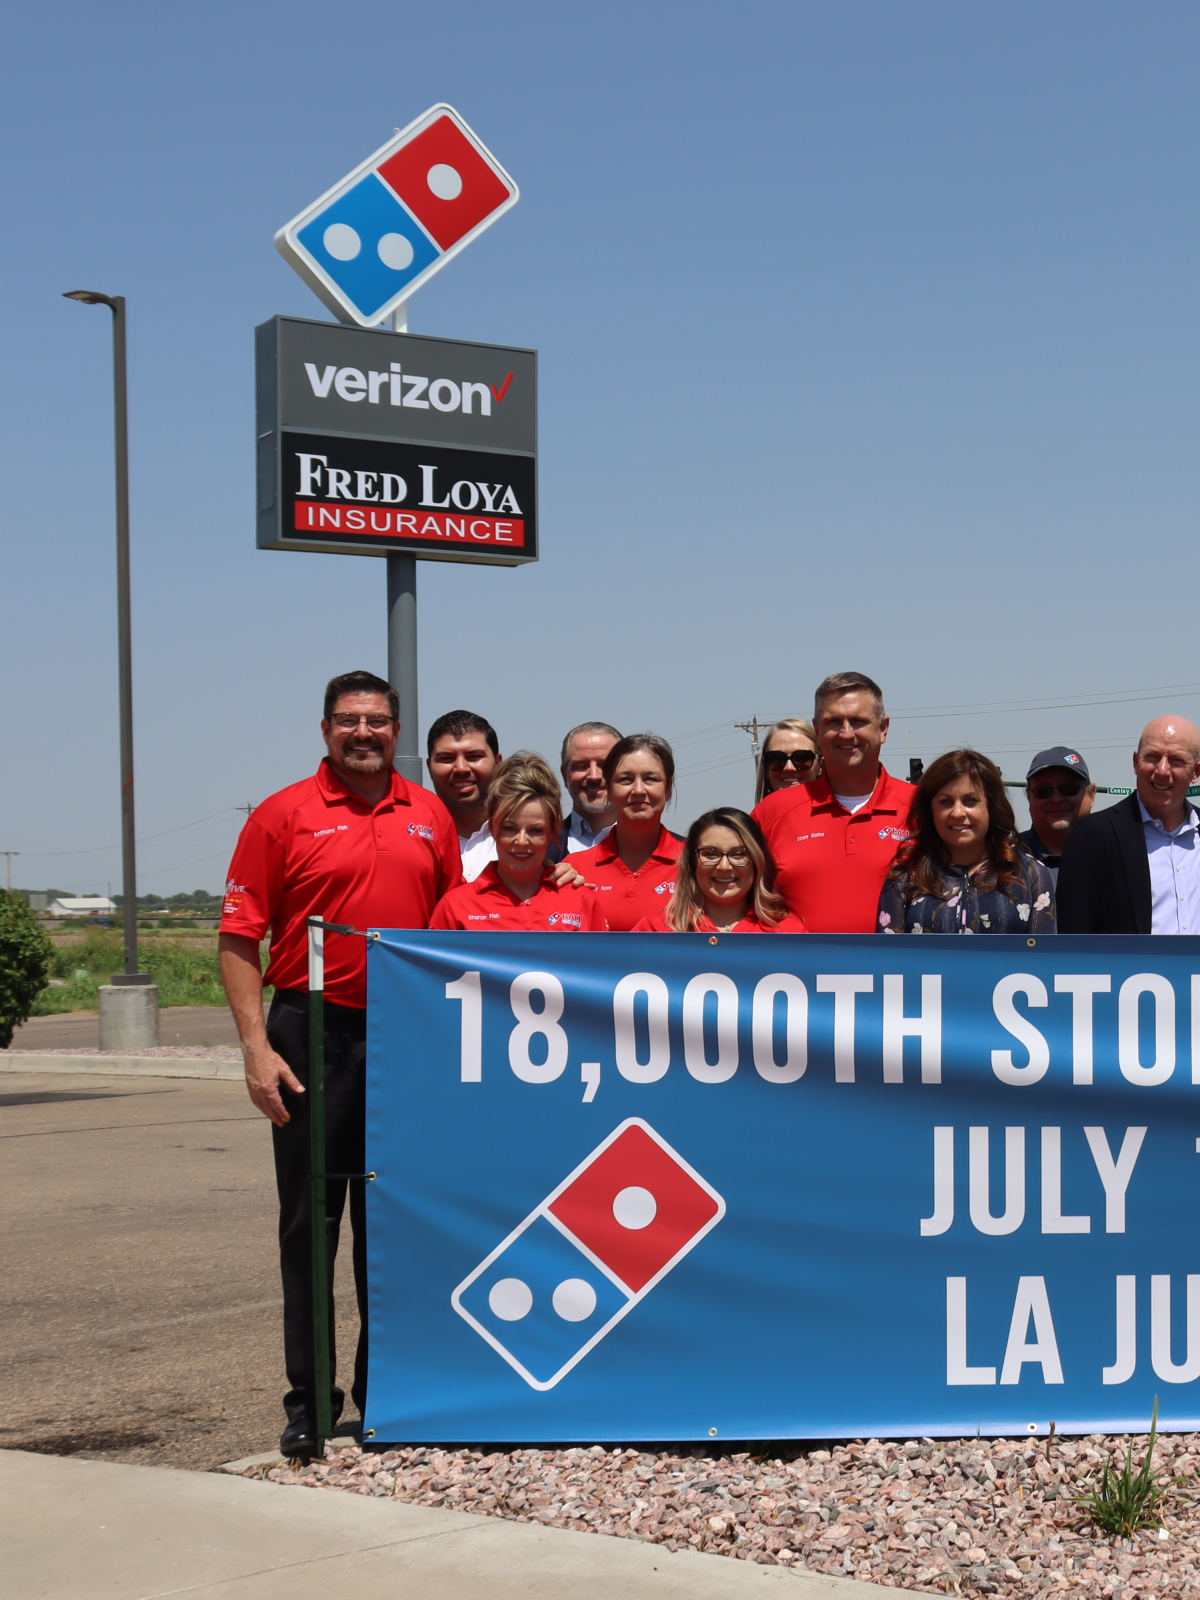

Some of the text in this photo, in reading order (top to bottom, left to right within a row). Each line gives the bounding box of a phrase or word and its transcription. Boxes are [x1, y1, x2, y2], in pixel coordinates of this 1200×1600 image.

[304, 362, 491, 416] verizon
[295, 452, 523, 514] FRED LOYA
[306, 506, 513, 542] INSURANCE
[1110, 787, 1130, 795] Conley
[313, 827, 335, 838] Anthony
[446, 971, 943, 1102] 18,000TH
[921, 1126, 1148, 1236] JULY
[947, 1276, 1065, 1386] LA
